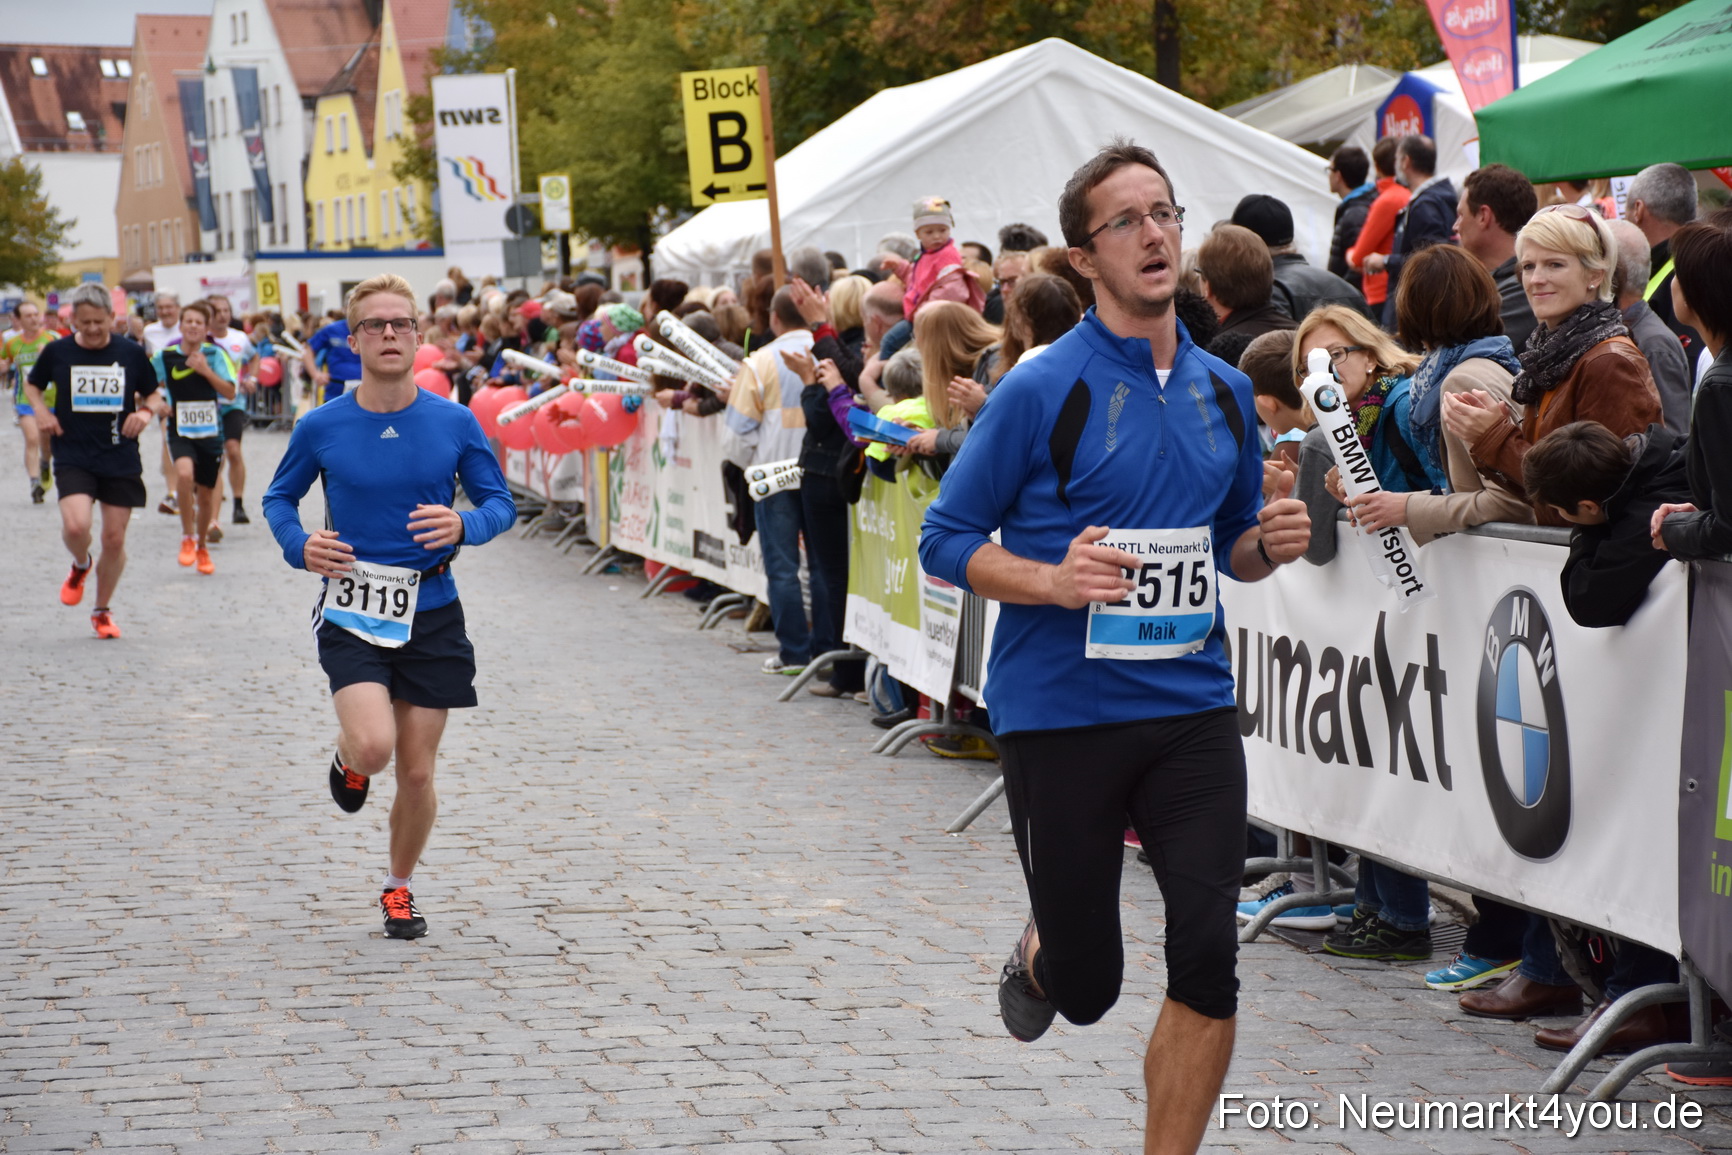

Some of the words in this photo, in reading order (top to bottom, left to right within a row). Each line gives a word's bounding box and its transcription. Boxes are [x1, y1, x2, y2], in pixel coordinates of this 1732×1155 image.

[693, 74, 759, 100] Block
[708, 110, 752, 174] B
[262, 281, 275, 298] D
[599, 361, 624, 374] BMW
[77, 377, 119, 394] 2173
[591, 384, 617, 393] BMW
[181, 411, 213, 424] 3095
[1332, 423, 1375, 484] BMW
[1149, 541, 1201, 554] Neumarkt
[362, 570, 404, 584] Neumarkt
[336, 577, 409, 618] 3119
[1138, 622, 1177, 640] Maik
[1485, 596, 1555, 688] BMW
[1224, 610, 1453, 792] umarkt
